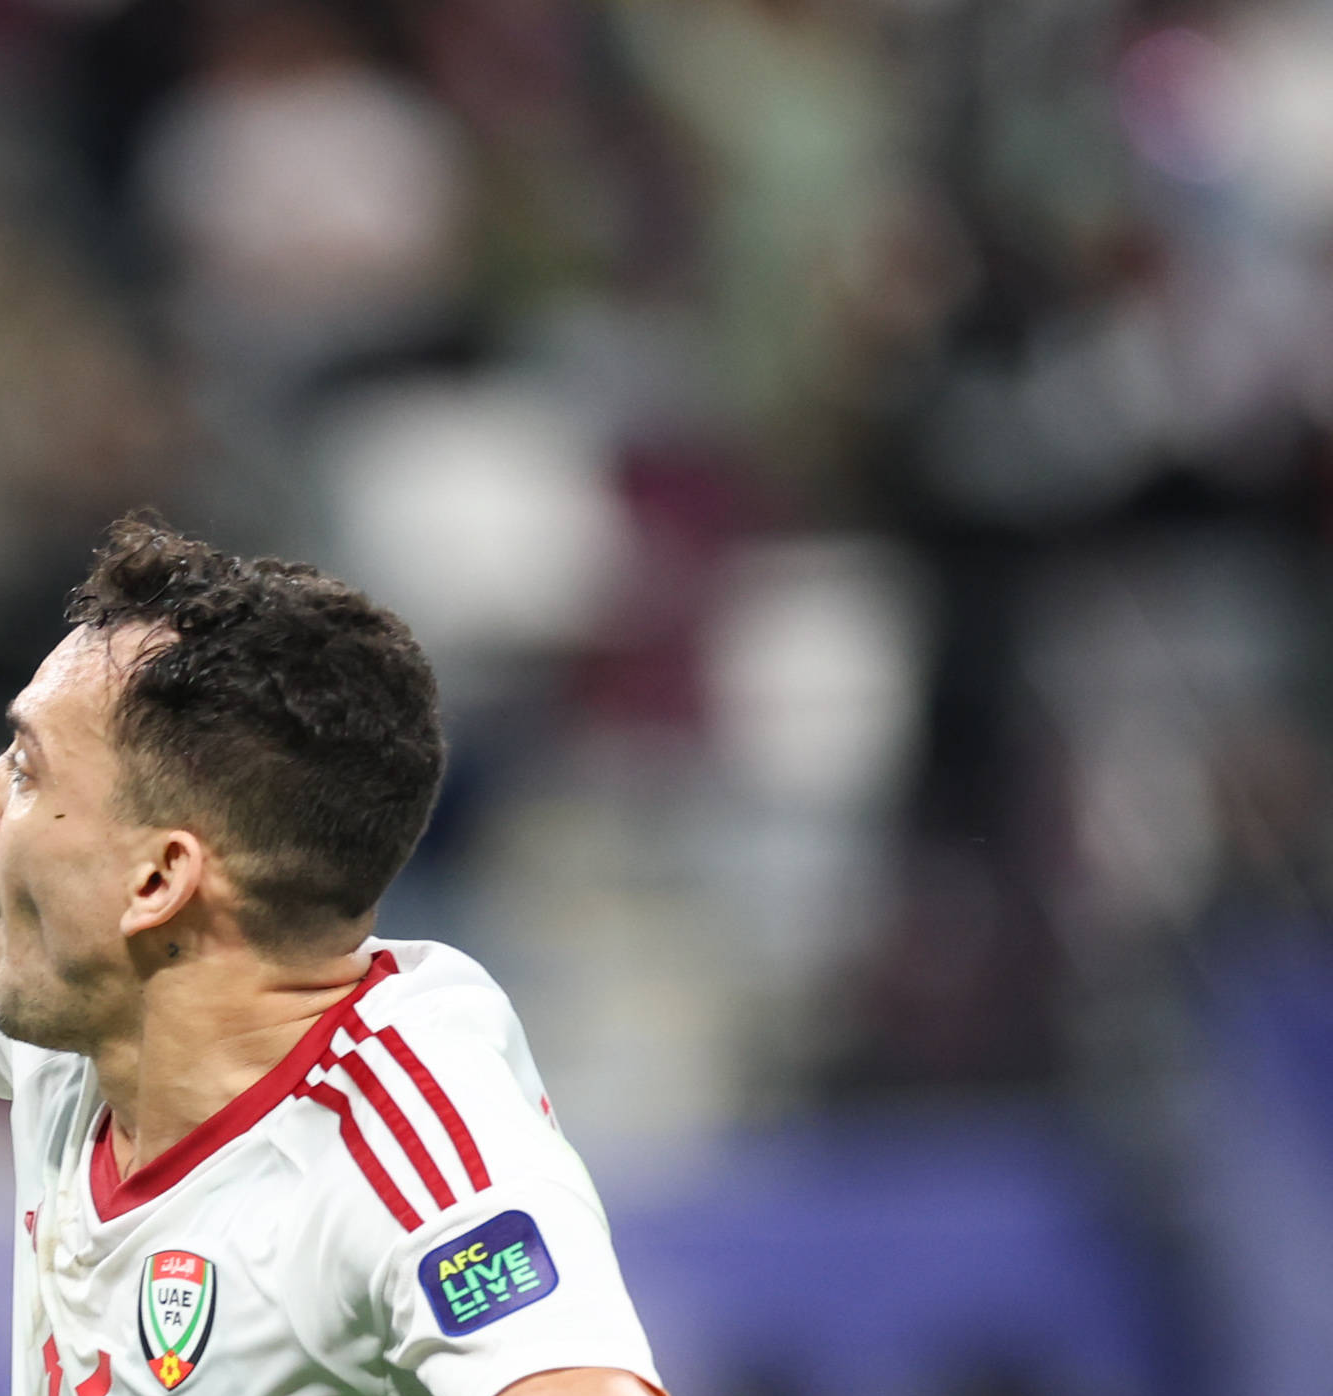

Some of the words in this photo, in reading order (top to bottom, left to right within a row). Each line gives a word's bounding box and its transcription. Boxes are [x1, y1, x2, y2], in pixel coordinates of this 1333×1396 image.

[439, 1242, 488, 1281] AFC
[442, 1241, 531, 1302] LIVE
[158, 1287, 192, 1307] UAE
[164, 1310, 182, 1326] FA
